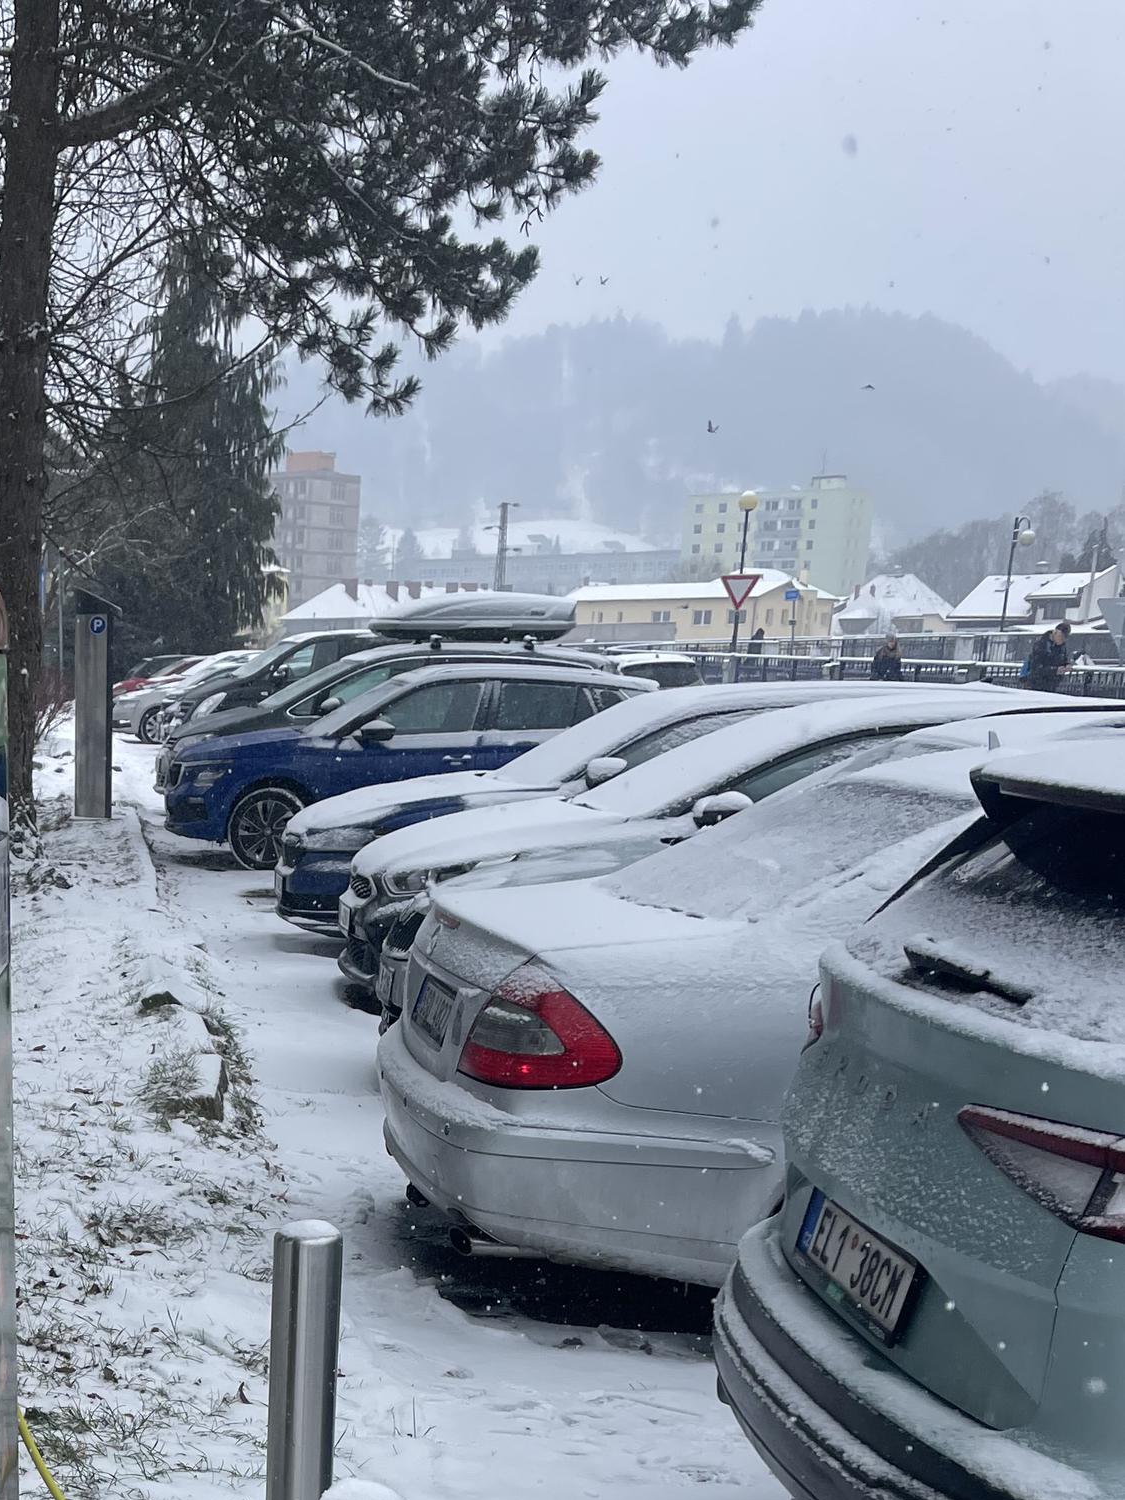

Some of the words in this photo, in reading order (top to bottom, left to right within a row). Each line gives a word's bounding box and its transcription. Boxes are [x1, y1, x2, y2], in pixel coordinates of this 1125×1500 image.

[93, 619, 103, 631] P
[810, 1206, 851, 1273] EL1
[850, 1240, 906, 1319] 38CM
